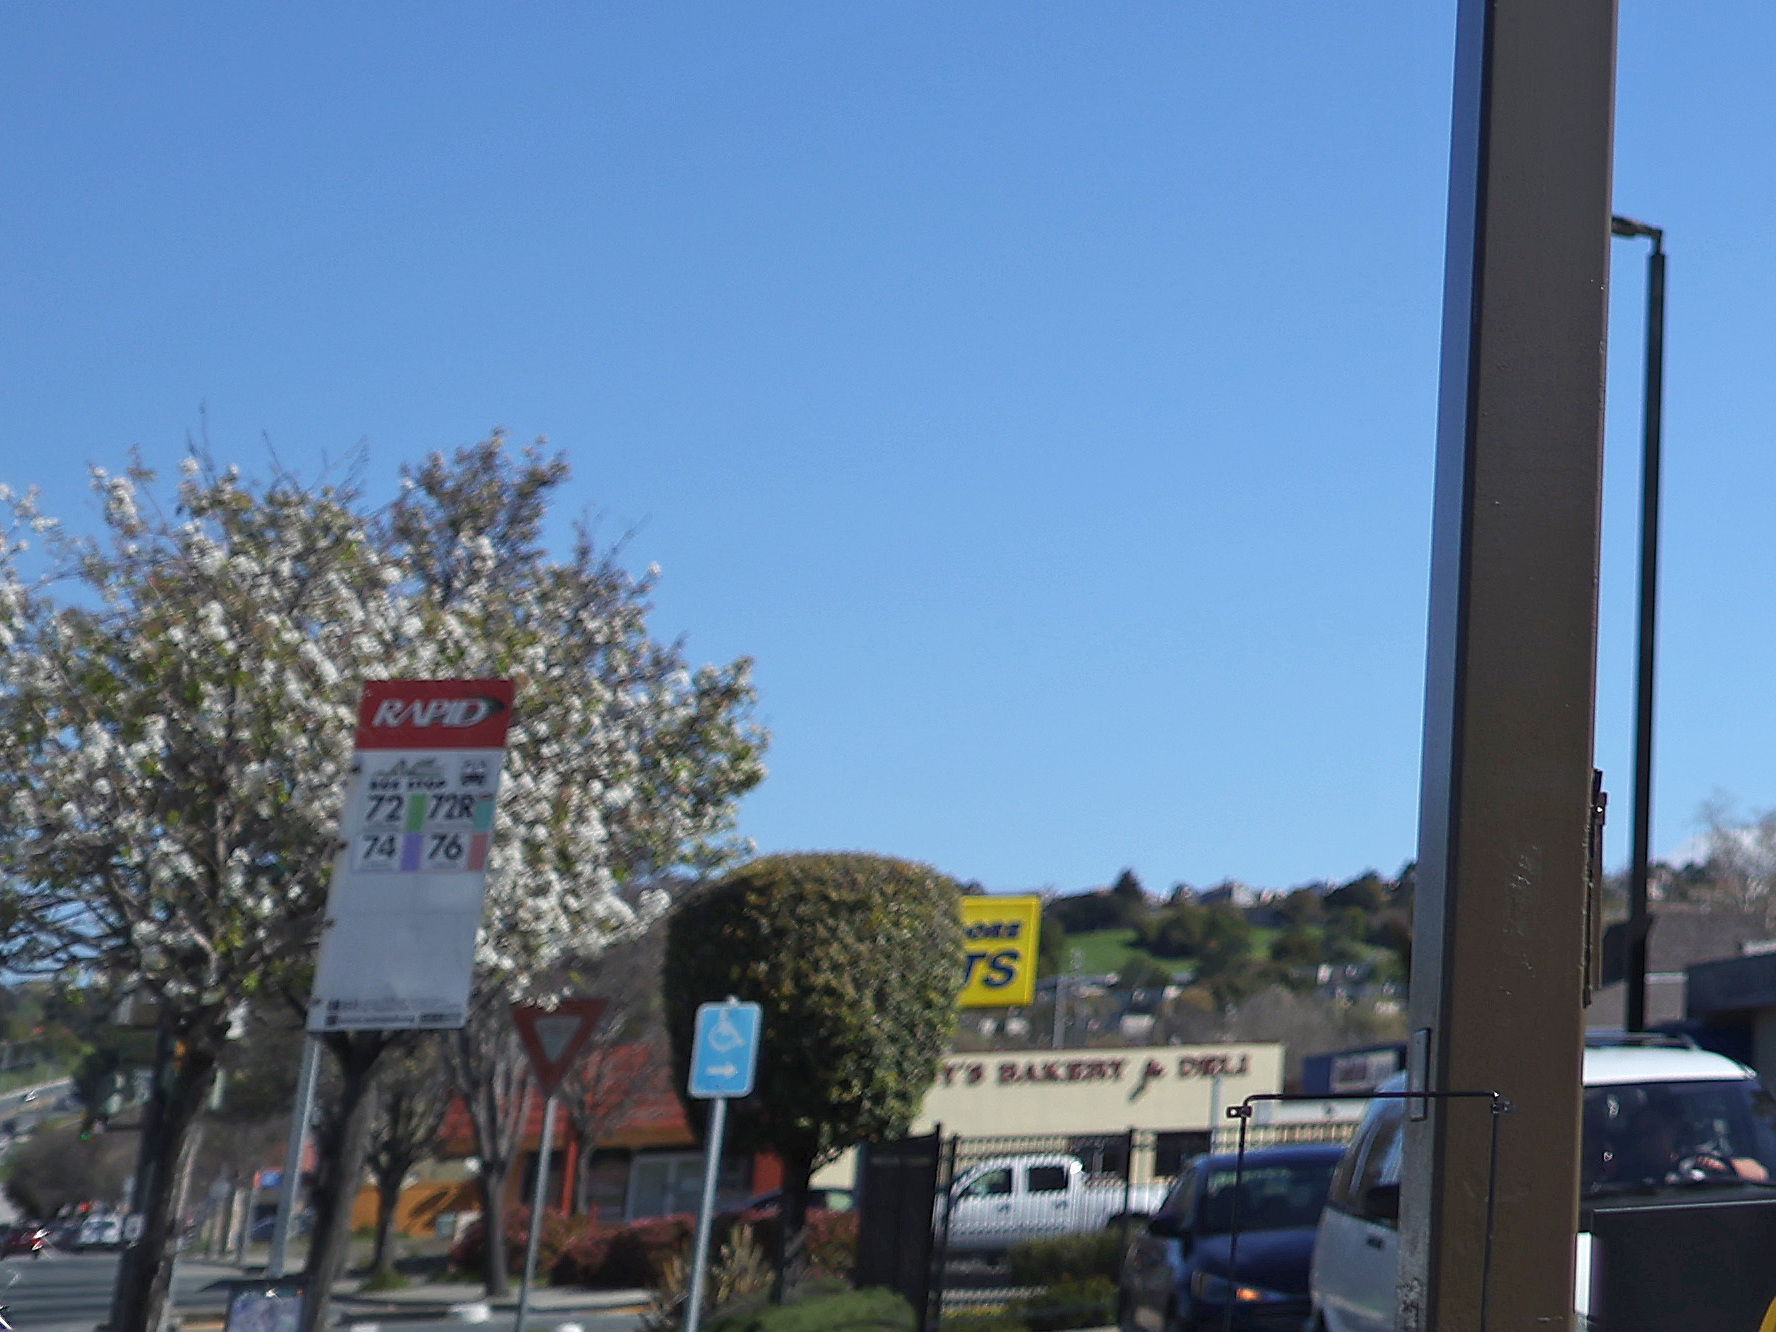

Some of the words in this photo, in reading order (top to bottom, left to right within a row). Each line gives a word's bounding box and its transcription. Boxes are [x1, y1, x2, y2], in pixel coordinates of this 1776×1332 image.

[371, 697, 492, 729] RAPID
[365, 794, 404, 822] 72
[428, 793, 475, 820] 72R
[363, 834, 397, 860] 74
[428, 833, 463, 861] 76
[999, 1057, 1124, 1083] BAKERY
[1179, 1053, 1248, 1078] DELI
